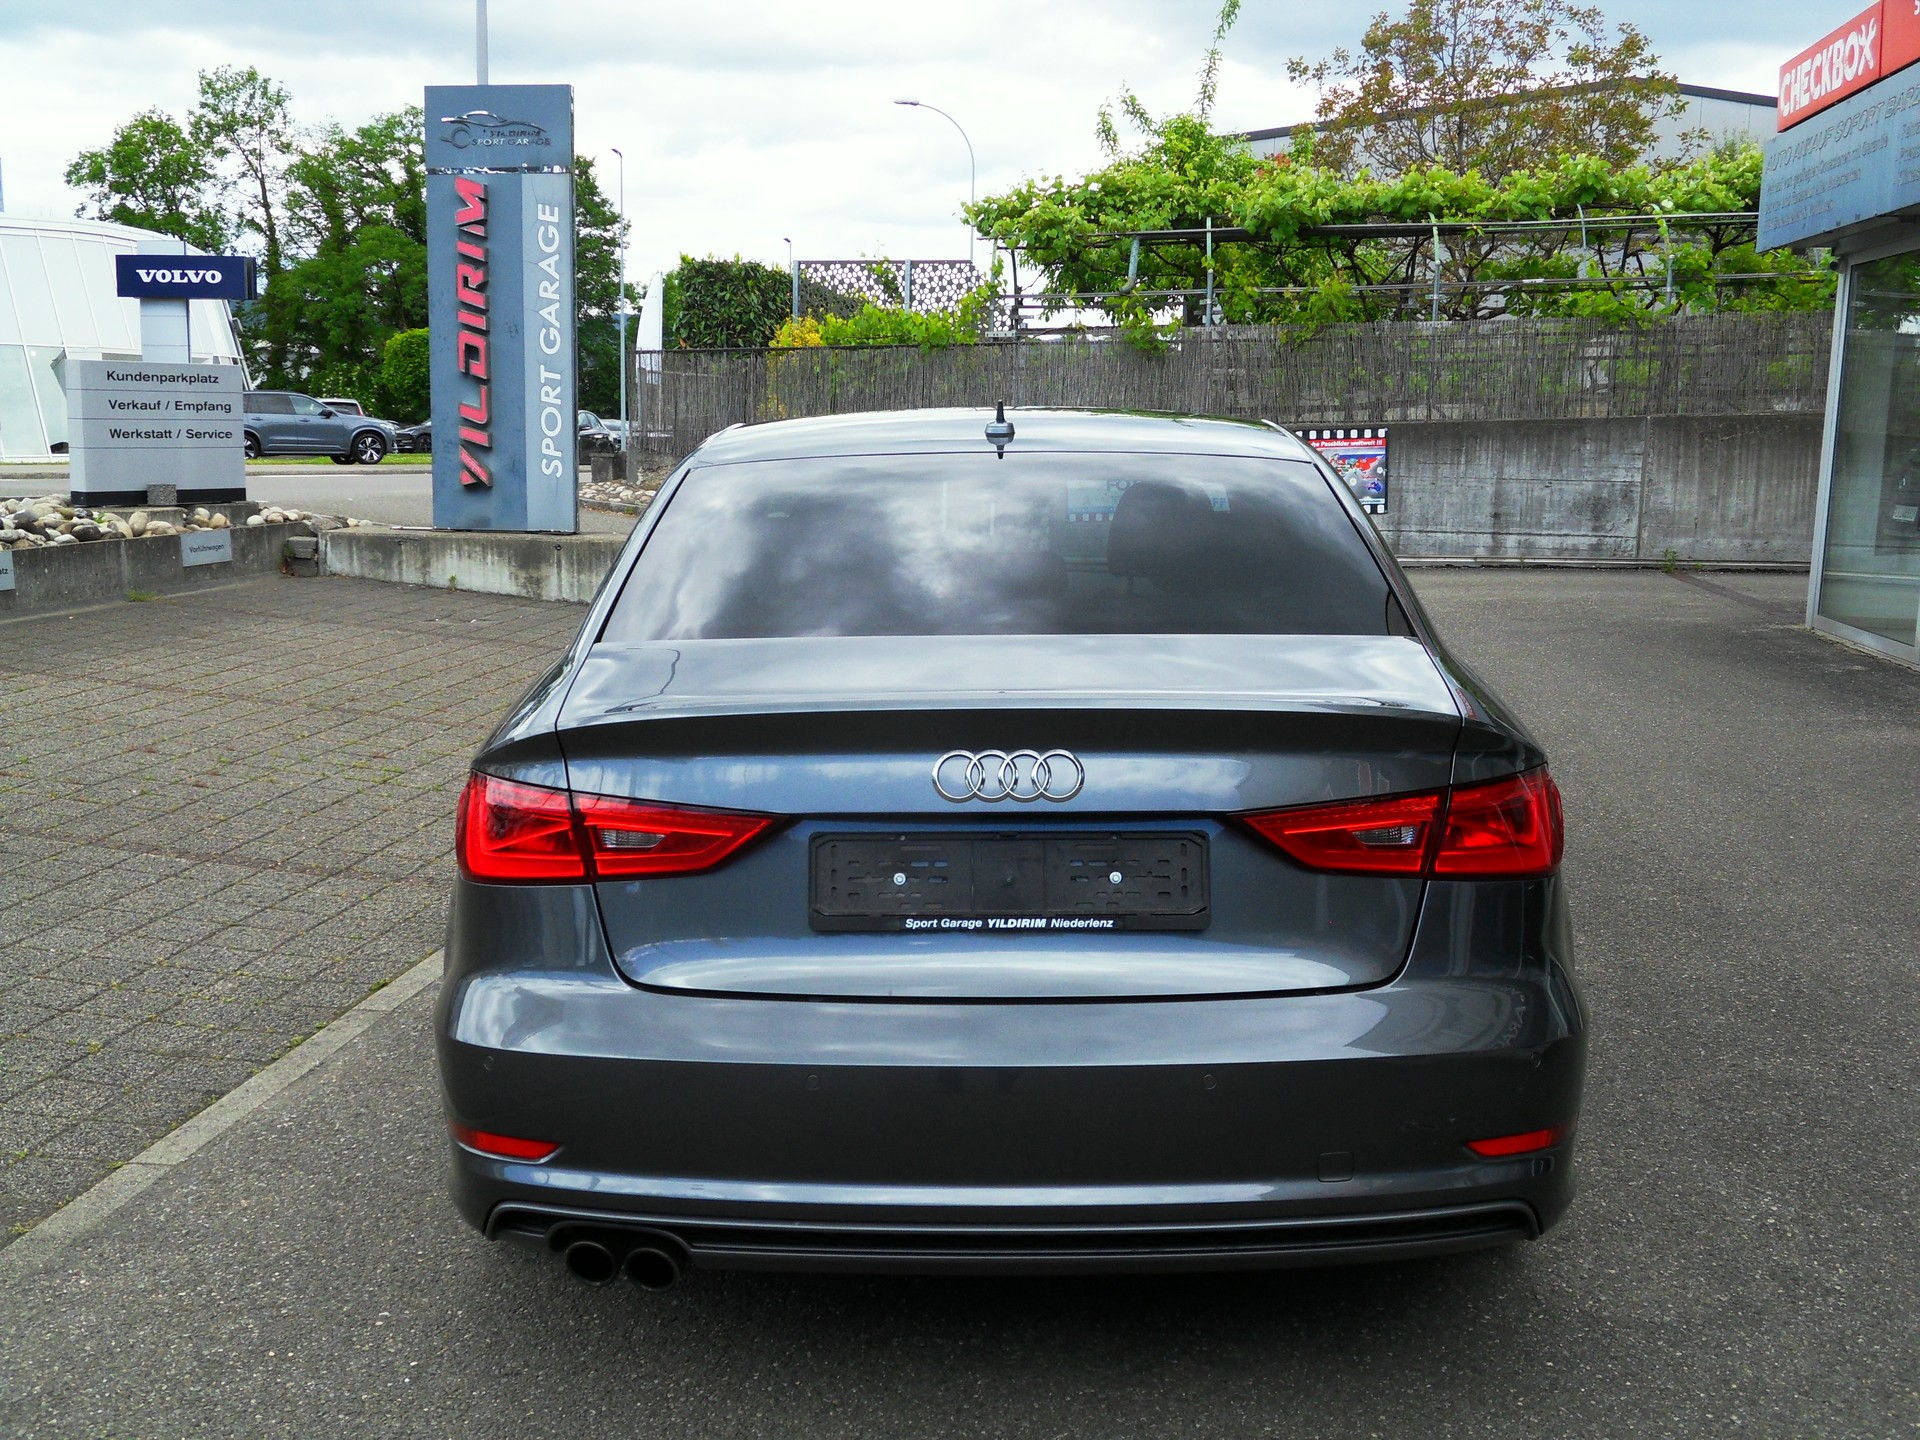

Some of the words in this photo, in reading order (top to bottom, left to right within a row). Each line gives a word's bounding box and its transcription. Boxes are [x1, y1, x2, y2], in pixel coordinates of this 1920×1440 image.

[1780, 17, 1877, 117] CHECKBOX
[472, 139, 504, 147] SPORT
[507, 138, 551, 147] GARAGE
[1765, 146, 1793, 174] AUTO
[1793, 126, 1834, 162] ANKAUF
[1835, 101, 1885, 143] SOFORT
[136, 269, 222, 284] VOLVO
[537, 203, 562, 355] GARAGE
[455, 176, 492, 488] YILDIRIM
[106, 370, 220, 385] Kundenparkplatz
[108, 399, 162, 411] Verkauf
[165, 400, 171, 411] /
[174, 400, 232, 413] Empfang
[540, 364, 563, 479] SPORT
[109, 428, 173, 439] Werkstatt
[176, 429, 182, 439] /
[186, 428, 233, 439] Service
[905, 918, 938, 929] Sport
[940, 918, 983, 930] Garage
[987, 918, 1047, 929] YILDIRIM
[1050, 918, 1114, 929] Niederlenz
